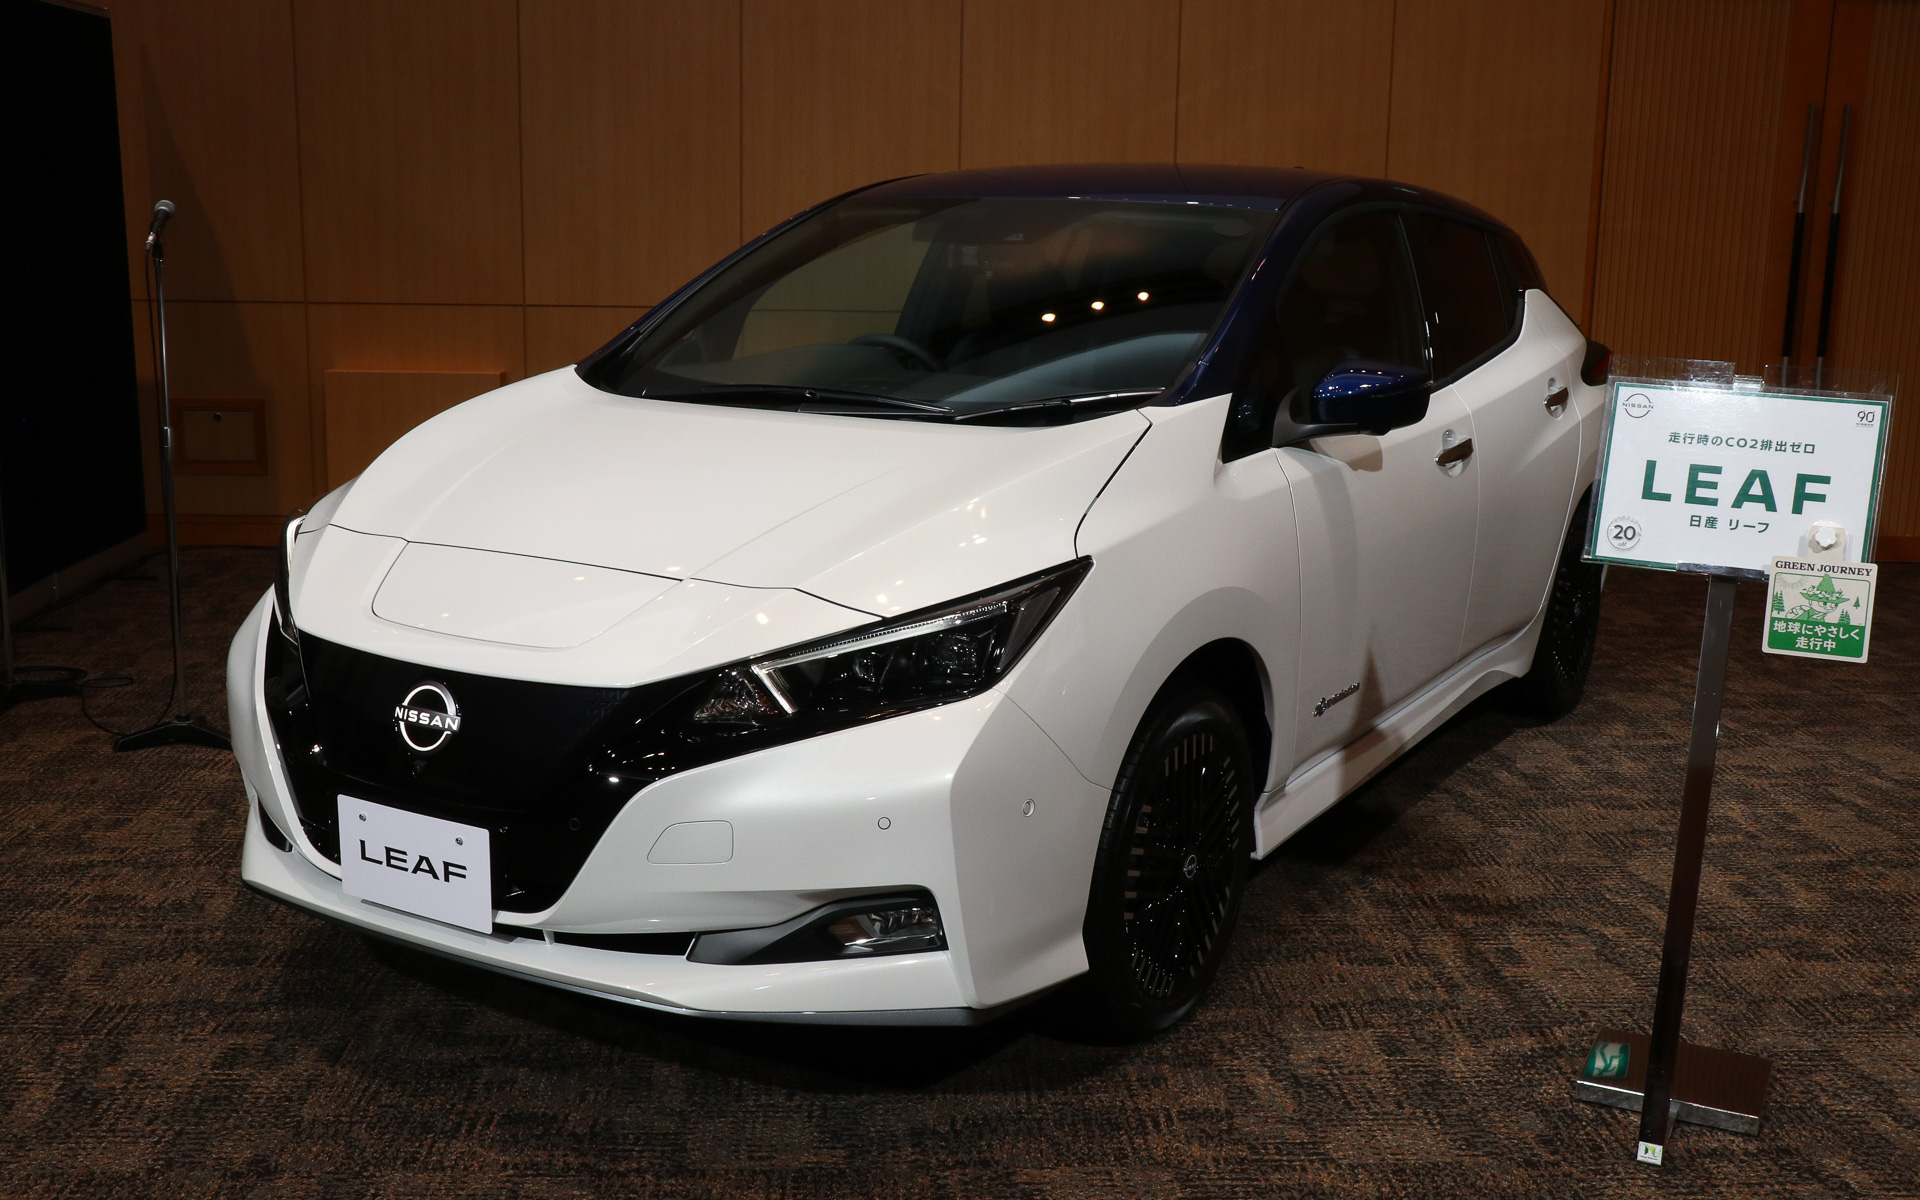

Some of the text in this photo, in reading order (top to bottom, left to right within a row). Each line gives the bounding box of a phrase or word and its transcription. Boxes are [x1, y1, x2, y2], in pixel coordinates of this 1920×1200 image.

[1857, 410, 1875, 422] 90
[1668, 431, 1816, 454] 走行時のCO2排出ゼロ
[1641, 459, 1831, 515] LEAF
[1612, 524, 1637, 541] 20
[1689, 514, 1770, 534] 日産 リーフ
[1775, 560, 1873, 577] GREEN JOURNEY
[1773, 620, 1860, 641] 地球にやさしく
[1795, 636, 1836, 652] 走行中
[394, 706, 459, 730] NISSAN
[359, 839, 467, 882] LEAF
